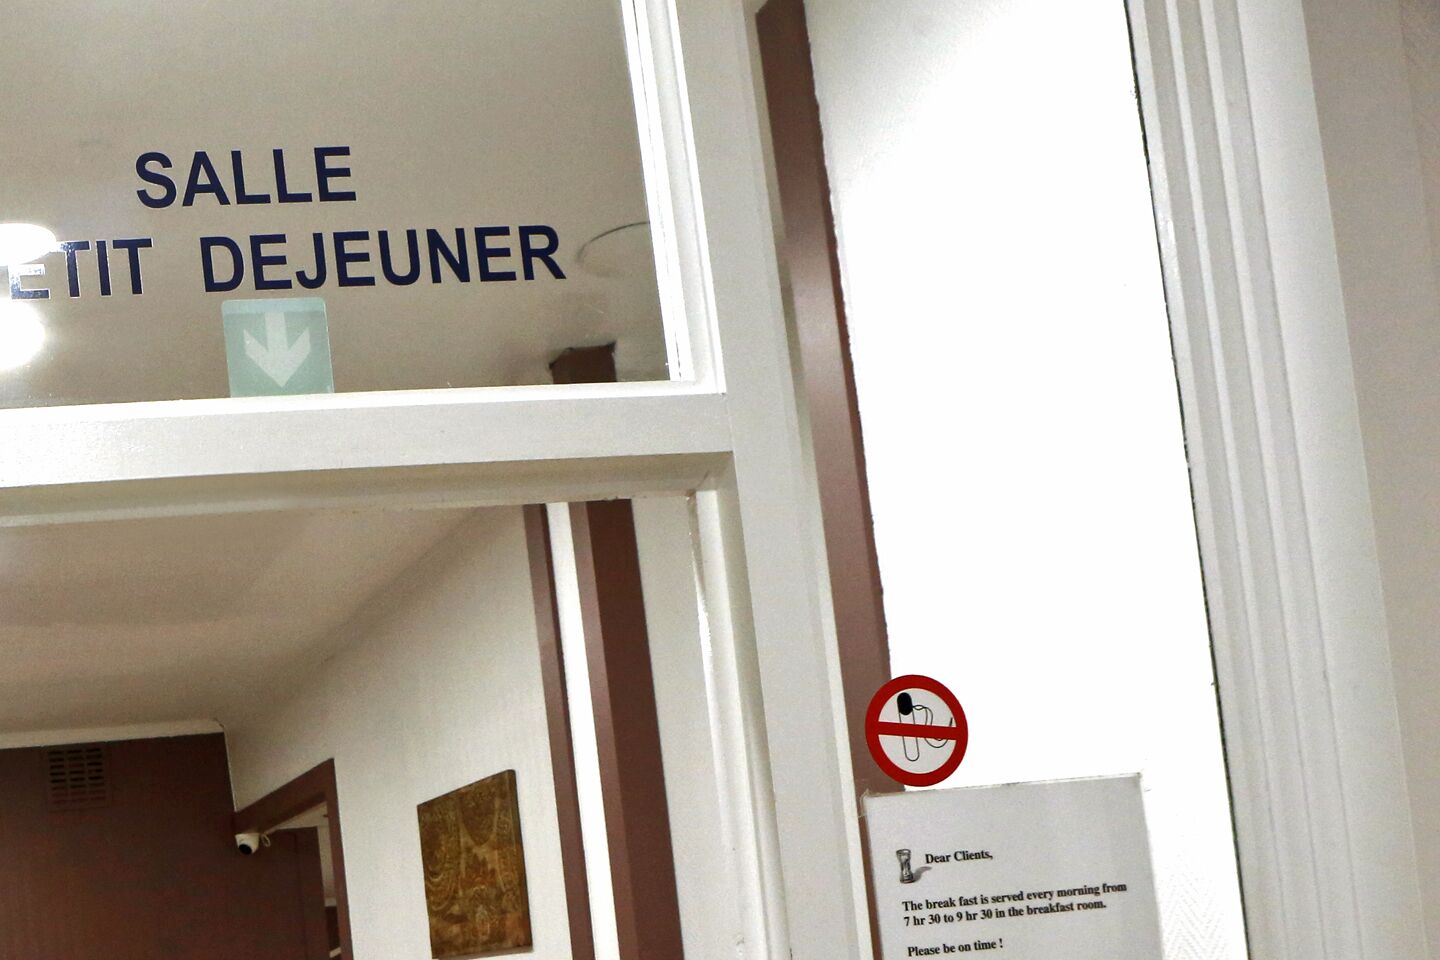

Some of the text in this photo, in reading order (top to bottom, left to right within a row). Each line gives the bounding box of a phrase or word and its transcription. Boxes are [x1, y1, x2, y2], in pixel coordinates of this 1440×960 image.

[135, 146, 357, 209] SALLE
[200, 225, 567, 293] DEJEUNER
[925, 850, 993, 864] Dear Clients,
[902, 883, 1127, 911] The break fast is served every morning from
[903, 900, 1107, 927] 7 hr 30 to 9 hr 30 in the breakfast room.
[907, 938, 1003, 957] Please be on time !
